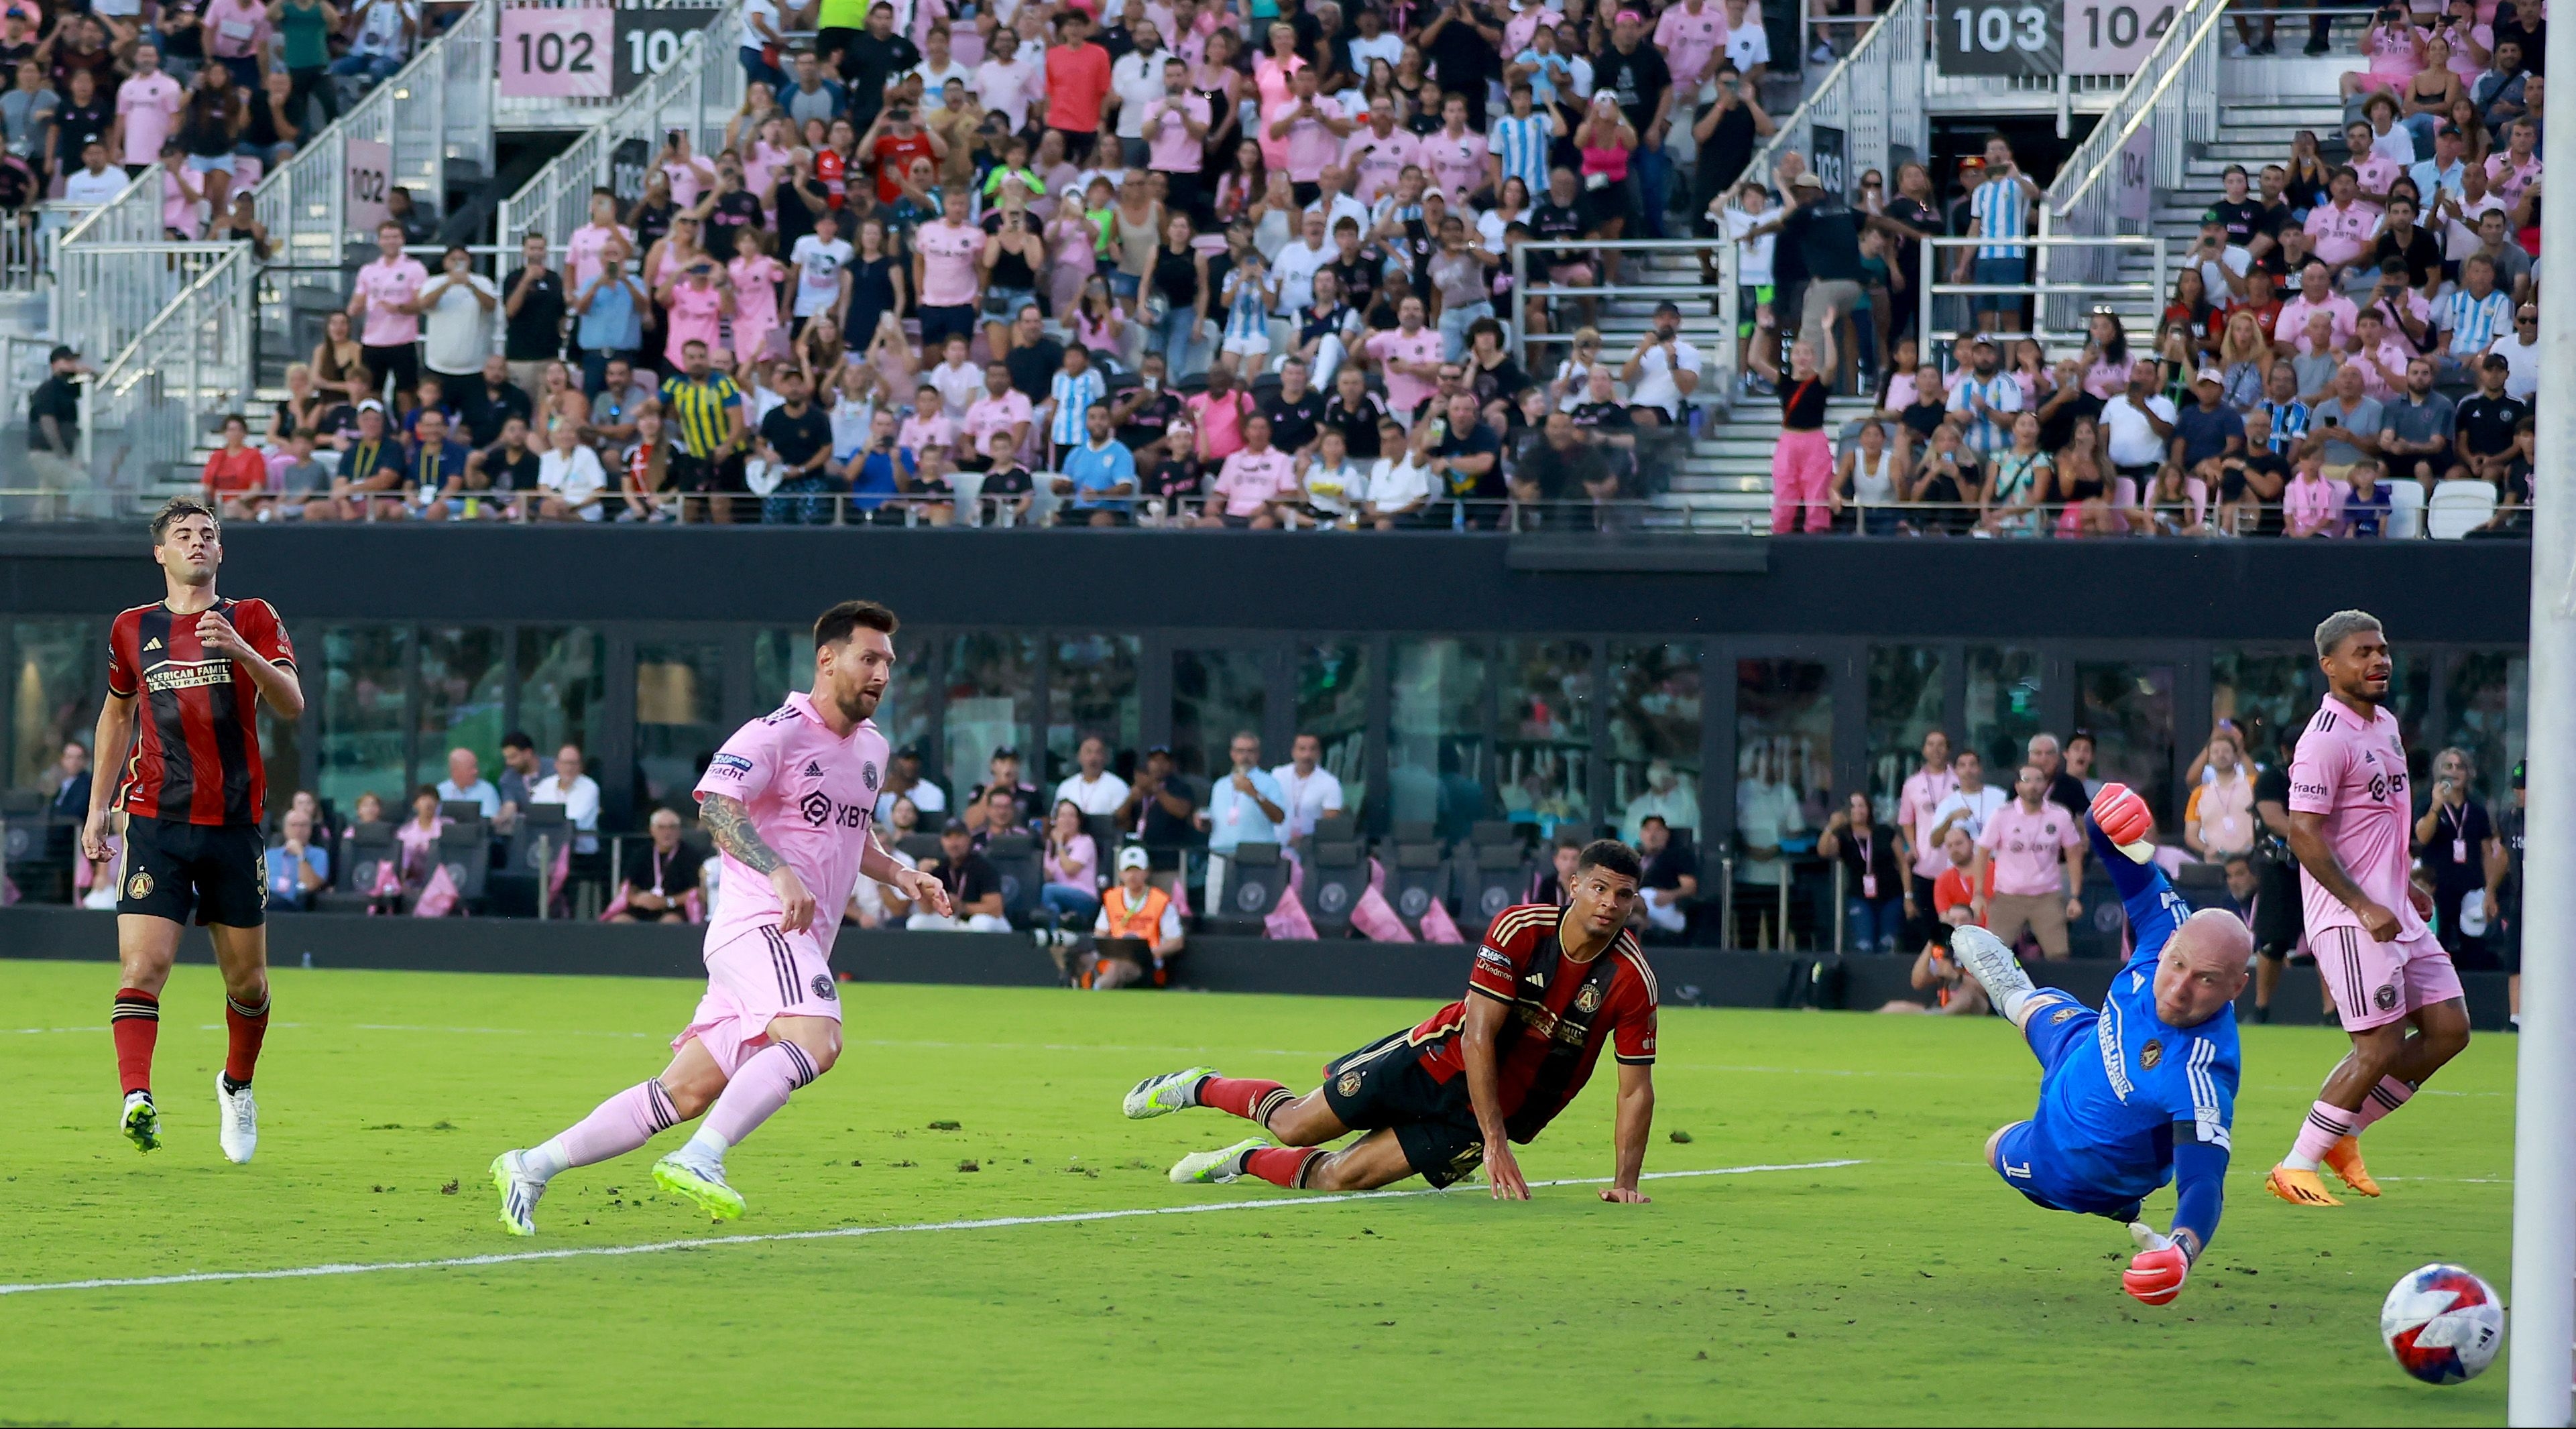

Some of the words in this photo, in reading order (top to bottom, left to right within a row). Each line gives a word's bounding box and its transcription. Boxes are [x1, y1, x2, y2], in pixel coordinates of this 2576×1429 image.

[1952, 7, 2045, 53] 103
[2083, 6, 2174, 49] 104
[518, 32, 594, 74] 102
[353, 168, 383, 204] 102
[1814, 152, 1841, 194] 103
[2123, 151, 2144, 190] 104
[835, 803, 874, 830] XBT
[133, 878, 145, 895] A
[1579, 991, 1592, 1007] A
